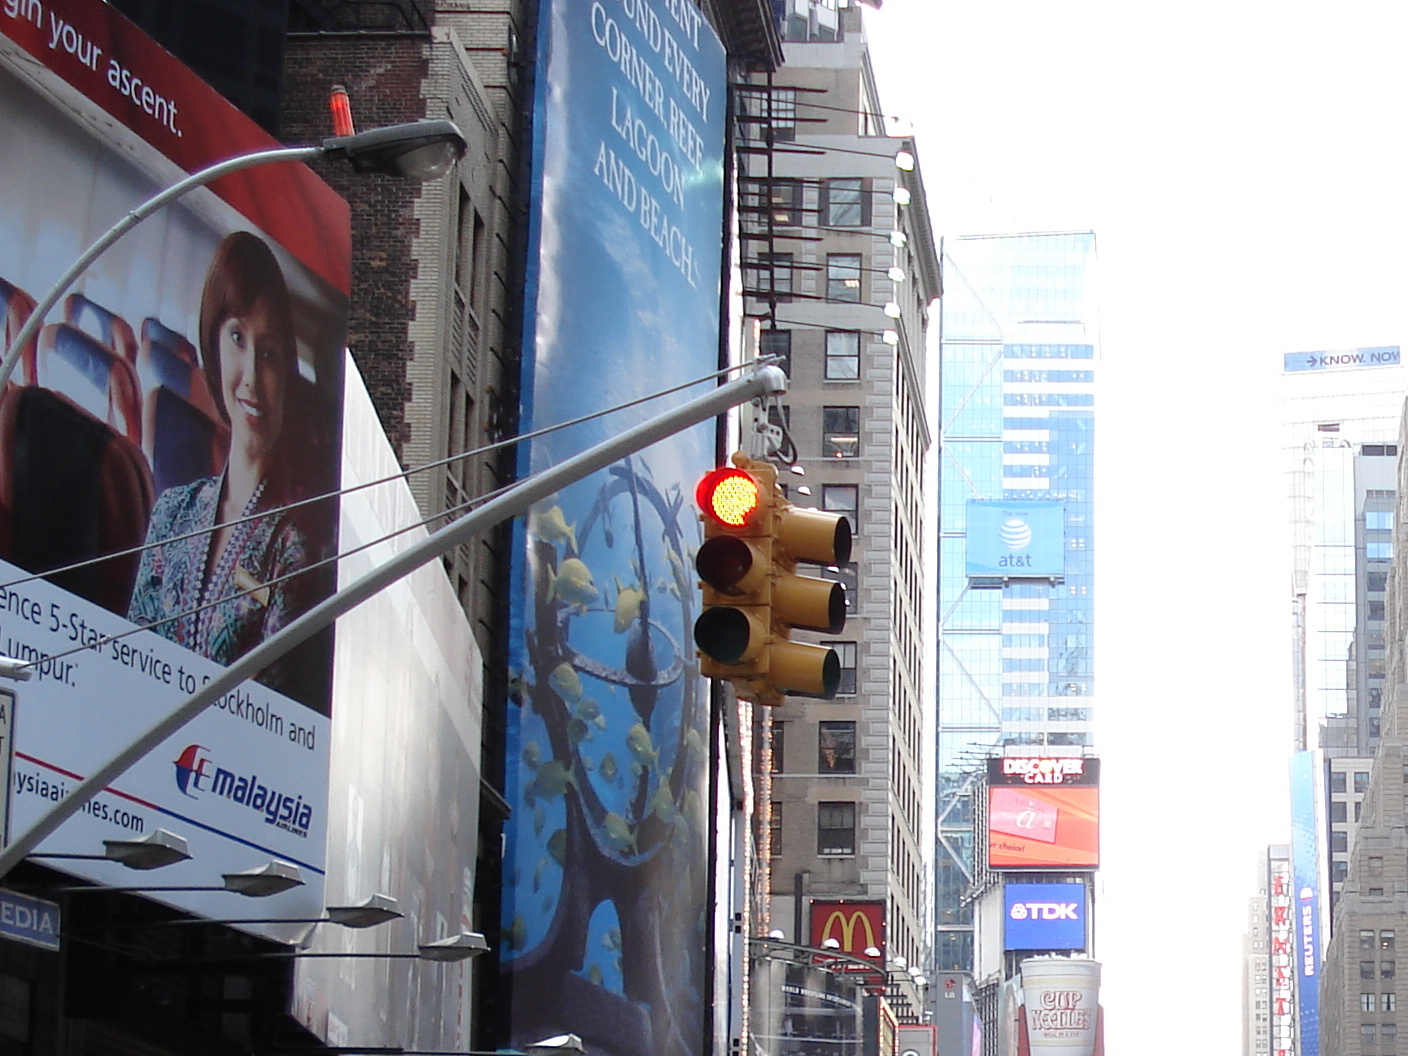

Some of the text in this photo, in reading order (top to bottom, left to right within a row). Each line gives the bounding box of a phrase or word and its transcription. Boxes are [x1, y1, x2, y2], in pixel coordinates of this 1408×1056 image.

[49, 12, 183, 138] your ascent.
[591, 1, 704, 171] CORNER, REEF
[664, 28, 710, 123] EVERY
[594, 141, 637, 212] AND
[611, 86, 684, 212] LAGOON
[998, 553, 1032, 568] at&t
[50, 603, 316, 751] 5-Star service to and
[211, 767, 312, 830] malaysia
[1003, 758, 1084, 775] DISCOVER
[1024, 773, 1064, 784] CARD
[1026, 903, 1079, 919] TDK
[1303, 904, 1315, 977] REUTERS
[1040, 991, 1082, 1010] CUP
